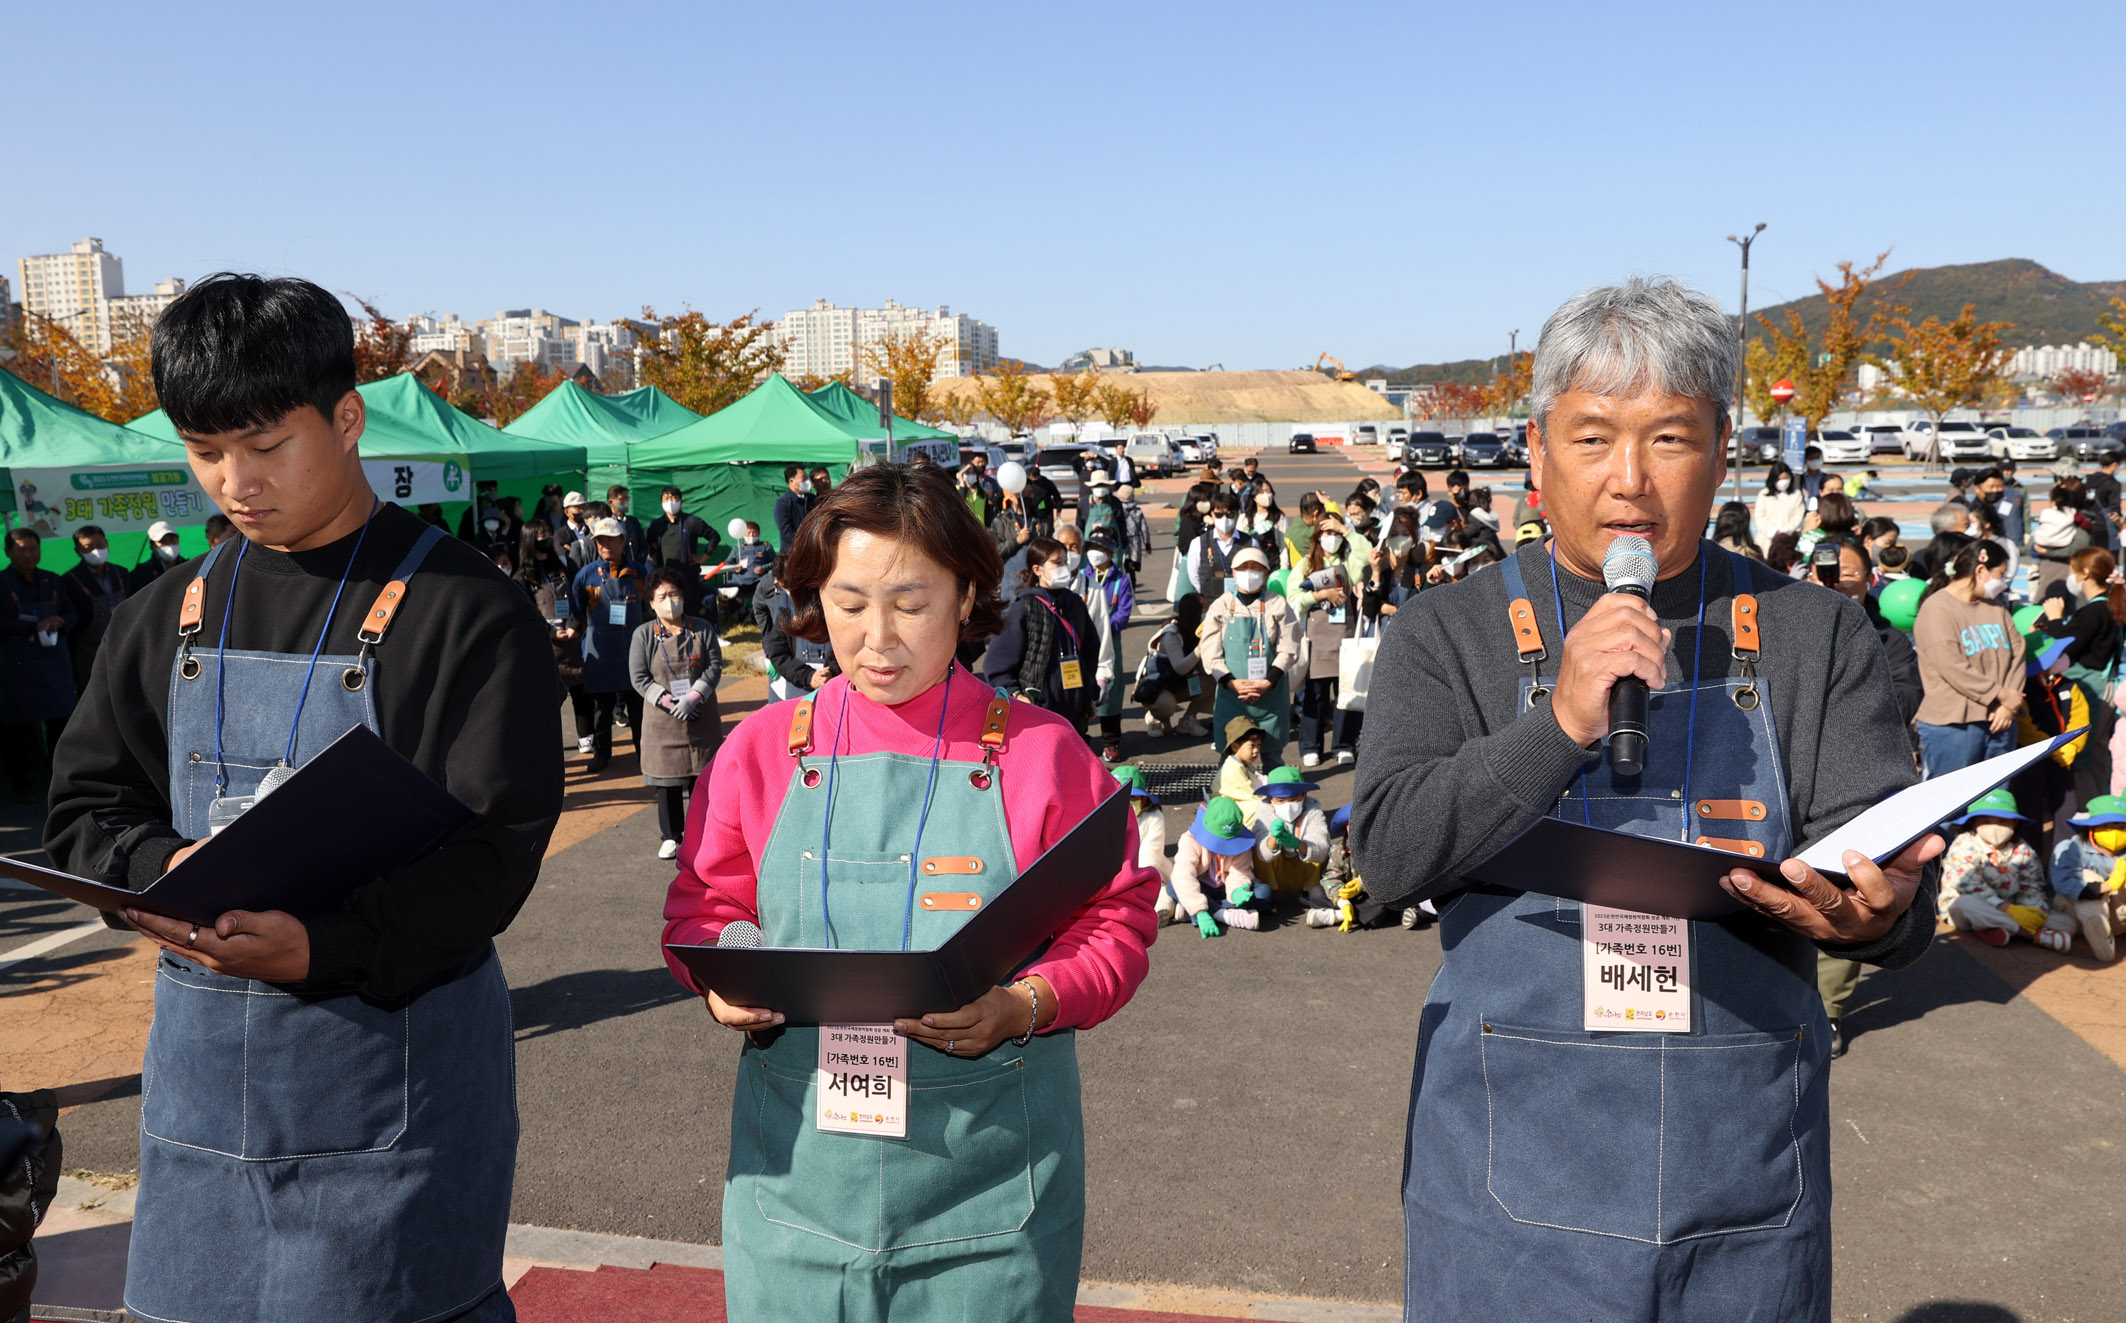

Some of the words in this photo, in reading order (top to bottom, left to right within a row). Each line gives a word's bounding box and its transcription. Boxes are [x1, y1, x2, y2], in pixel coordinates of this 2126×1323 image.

[394, 465, 413, 498] 장
[65, 497, 94, 521] 3대
[97, 491, 158, 521] 가족정원
[160, 490, 202, 517] 만들기
[1598, 923, 1613, 932] 3대
[1615, 923, 1677, 934] 가족정원만들기
[1596, 942, 1647, 955] [가족번호
[1652, 944, 1681, 957] 16번]
[1600, 964, 1677, 993] 배세헌
[831, 1033, 842, 1041] 3대
[845, 1034, 896, 1045] 가족정원만들기
[827, 1052, 869, 1065] [가족번호
[873, 1056, 898, 1068] 16번]
[828, 1072, 891, 1100] 서여희
